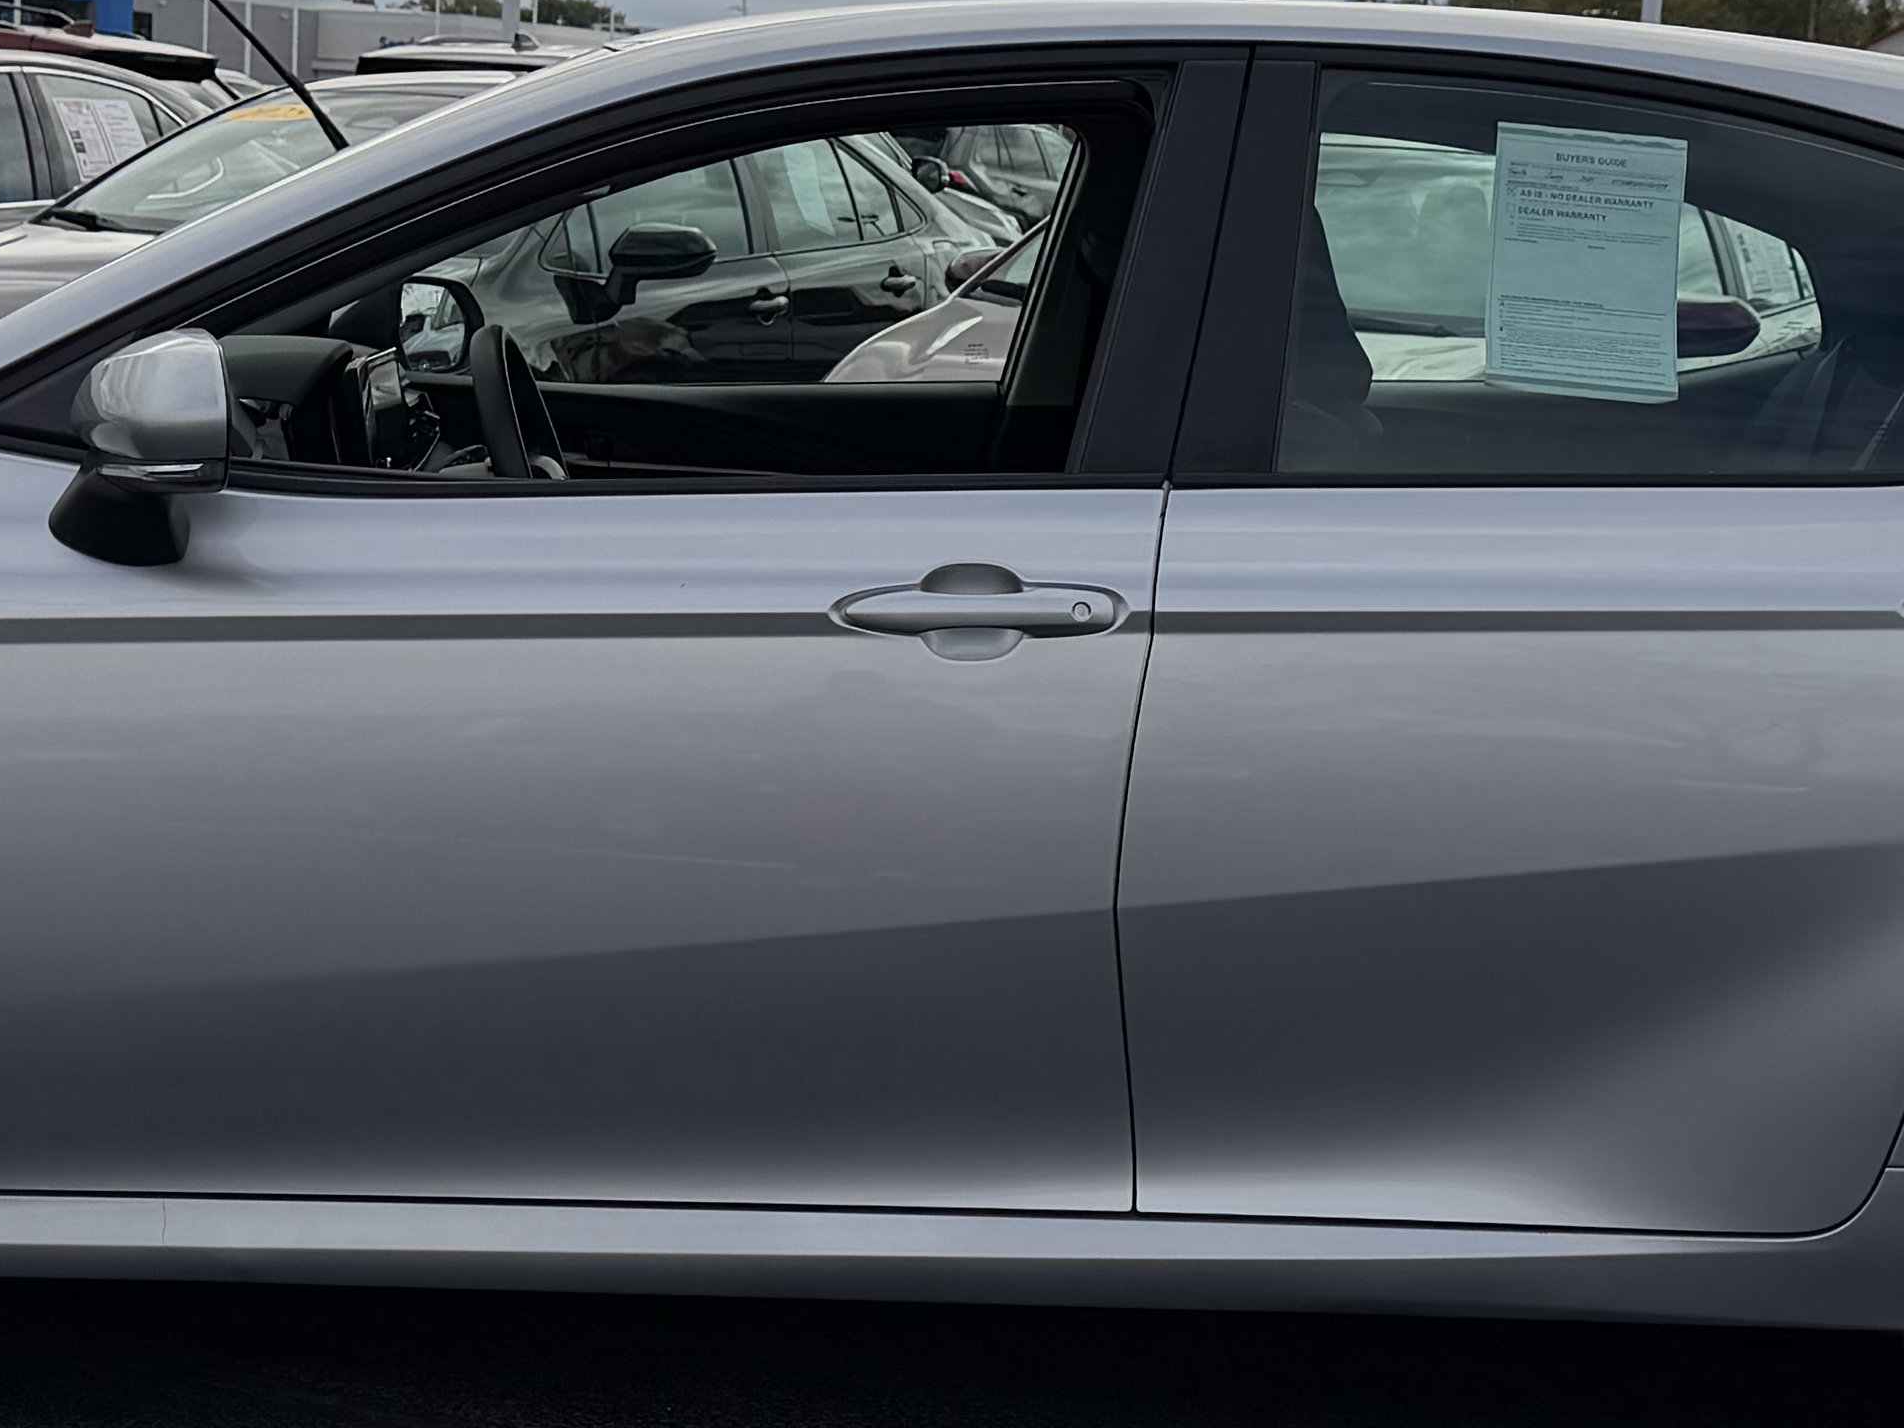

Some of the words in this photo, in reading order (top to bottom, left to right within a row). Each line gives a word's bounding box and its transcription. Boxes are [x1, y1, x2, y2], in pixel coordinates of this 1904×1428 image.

[1556, 152, 1595, 164] BUYERS
[1597, 156, 1627, 168] GUIDE
[1520, 189, 1532, 197] AS
[1550, 192, 1564, 201] NO
[1565, 193, 1602, 204] DEALER
[1603, 197, 1655, 208] WARRANTY
[1518, 206, 1554, 217] DEALER
[1556, 210, 1607, 221] WARRANTY
